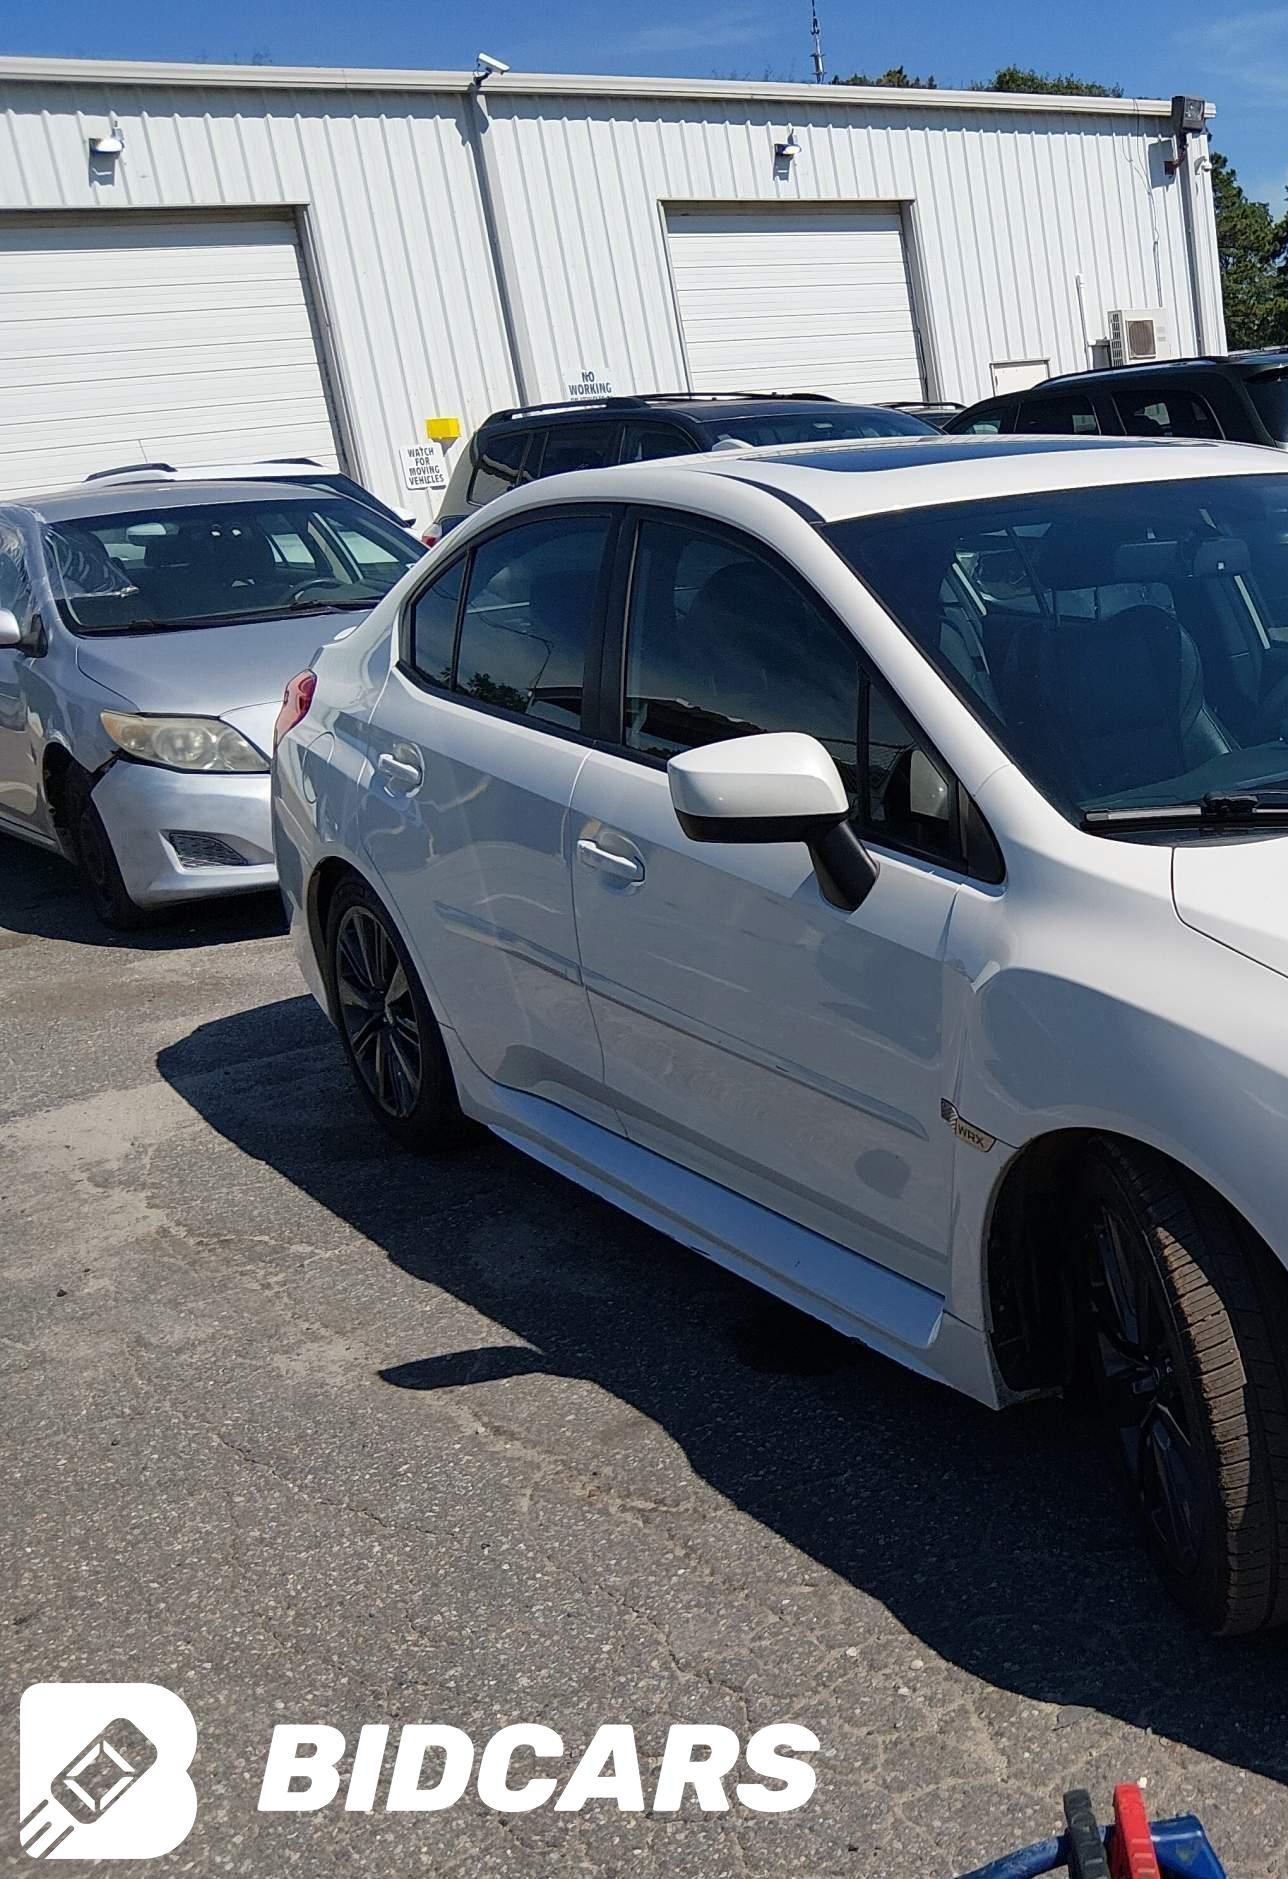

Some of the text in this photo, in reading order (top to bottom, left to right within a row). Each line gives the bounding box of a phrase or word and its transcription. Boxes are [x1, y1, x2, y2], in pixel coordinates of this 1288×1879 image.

[581, 371, 595, 383] NO
[568, 382, 612, 396] WORKING
[407, 447, 434, 458] WATCH
[415, 457, 430, 466] FOR
[409, 465, 440, 476] MOVING
[408, 474, 445, 485] VEHICLES
[958, 1123, 985, 1148] WRX
